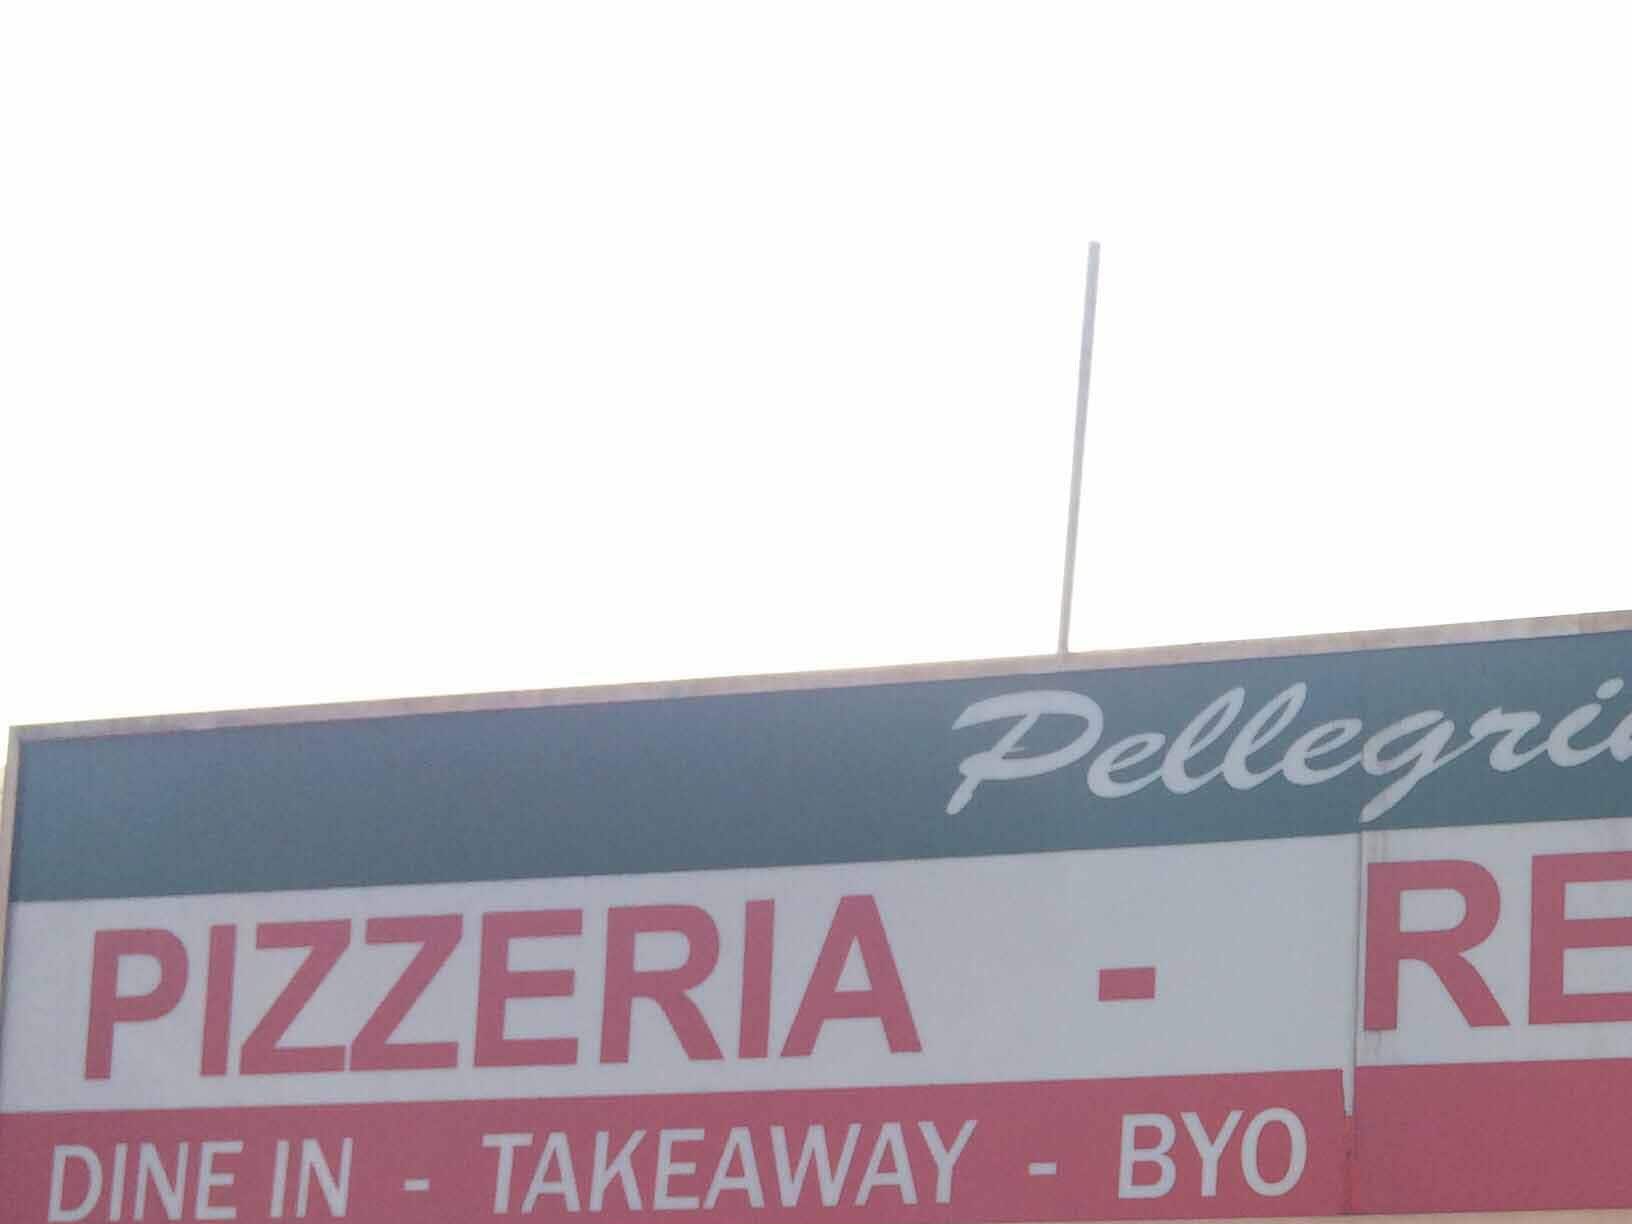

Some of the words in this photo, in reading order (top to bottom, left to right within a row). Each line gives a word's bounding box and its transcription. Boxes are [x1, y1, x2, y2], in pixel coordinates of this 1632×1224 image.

[84, 894, 923, 1080] PIZZERIA
[1098, 966, 1156, 1002] -
[47, 1140, 243, 1224] DINE
[270, 1137, 354, 1218] IN
[482, 1118, 977, 1216] TAKEAWAY
[1117, 1107, 1309, 1200] BYO
